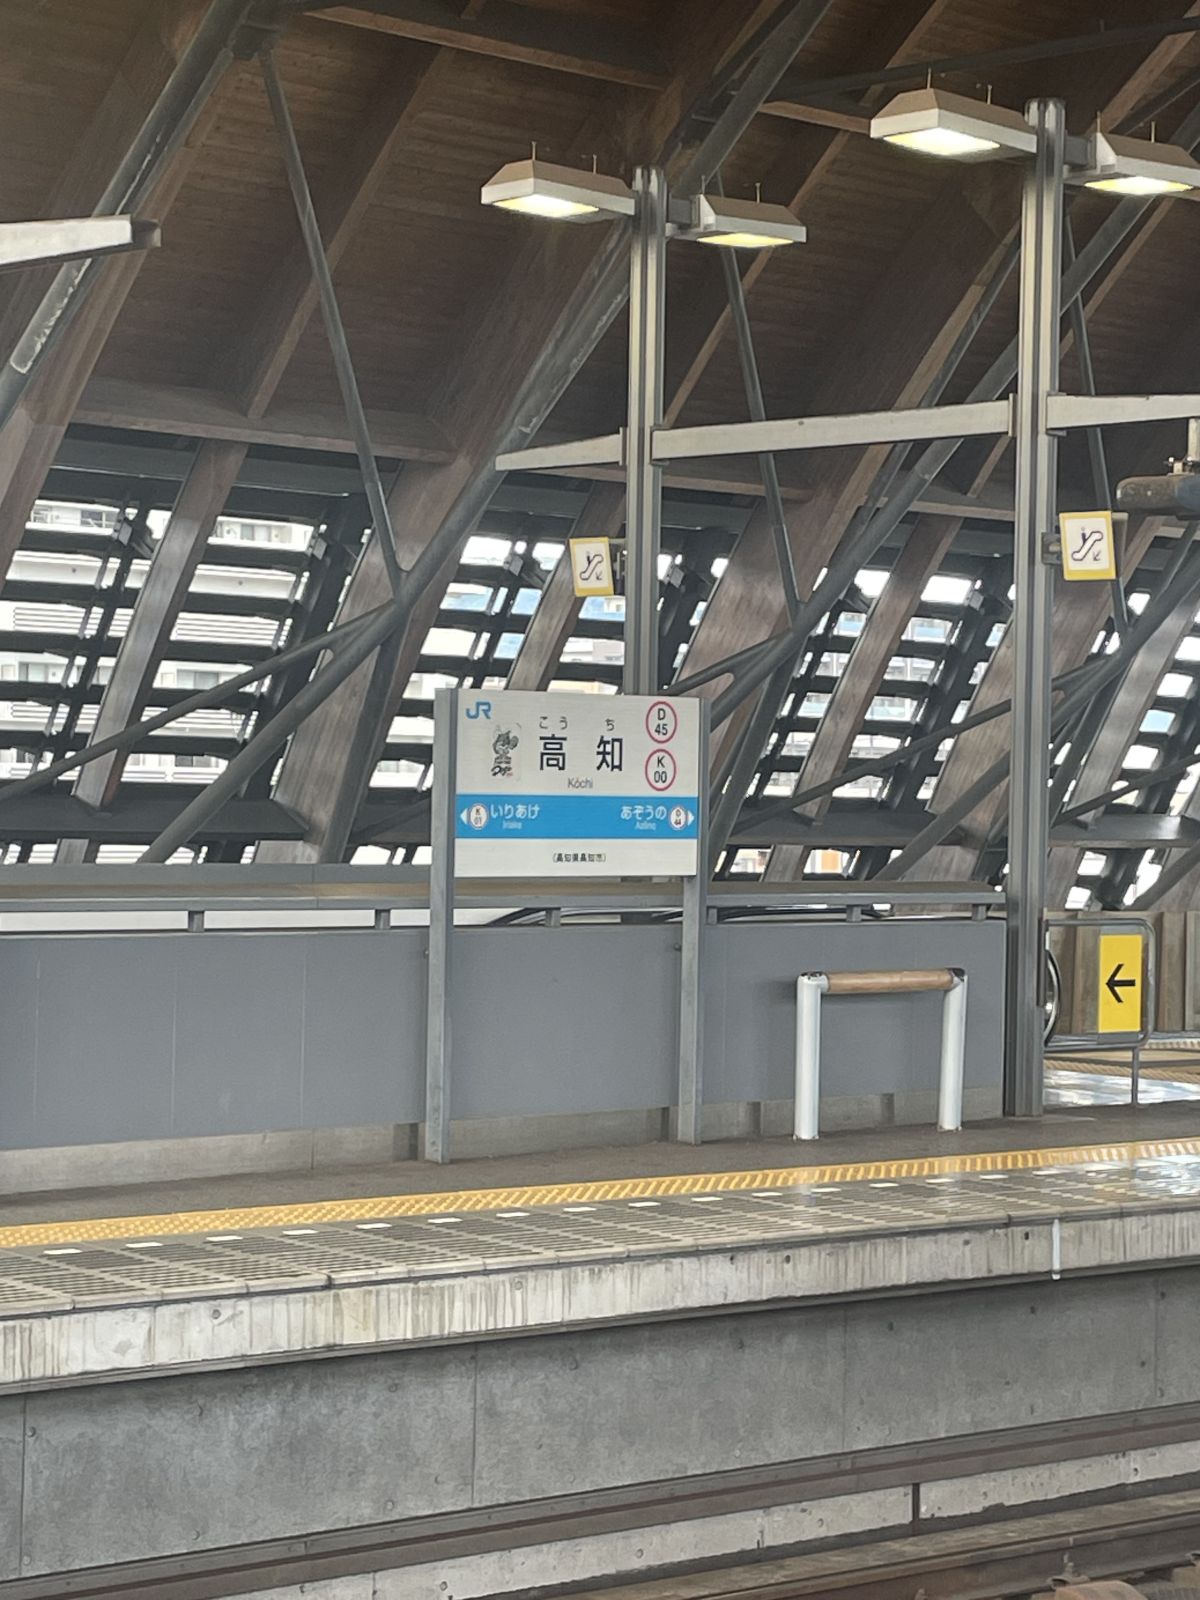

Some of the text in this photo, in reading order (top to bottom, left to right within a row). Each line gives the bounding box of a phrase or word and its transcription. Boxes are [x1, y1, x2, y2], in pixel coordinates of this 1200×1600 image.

[466, 701, 491, 719] JR
[657, 708, 666, 720] D
[654, 723, 668, 736] 45
[657, 756, 665, 768] K
[653, 771, 667, 783] 00
[490, 804, 540, 819] いりあけ
